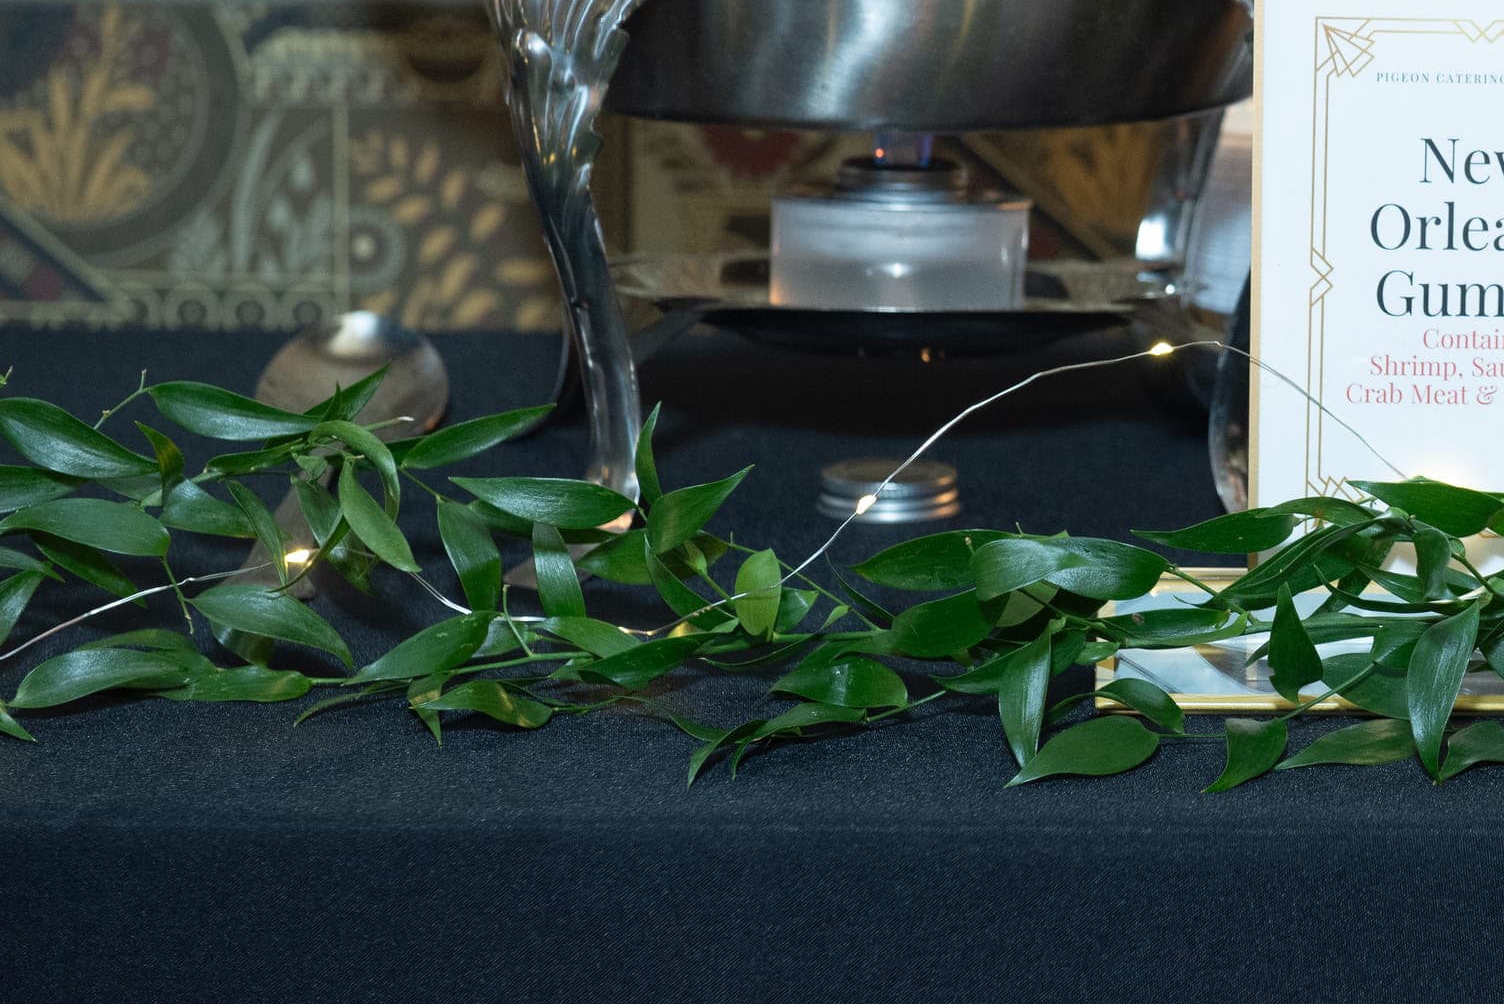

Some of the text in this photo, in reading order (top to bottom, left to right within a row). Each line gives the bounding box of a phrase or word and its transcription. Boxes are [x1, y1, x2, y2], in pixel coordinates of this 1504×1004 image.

[1376, 71, 1430, 83] PIGEON
[1370, 355, 1464, 381] Shrimp,
[1346, 382, 1402, 405] Crab
[1411, 384, 1469, 406] Meat
[1476, 384, 1497, 406] &
